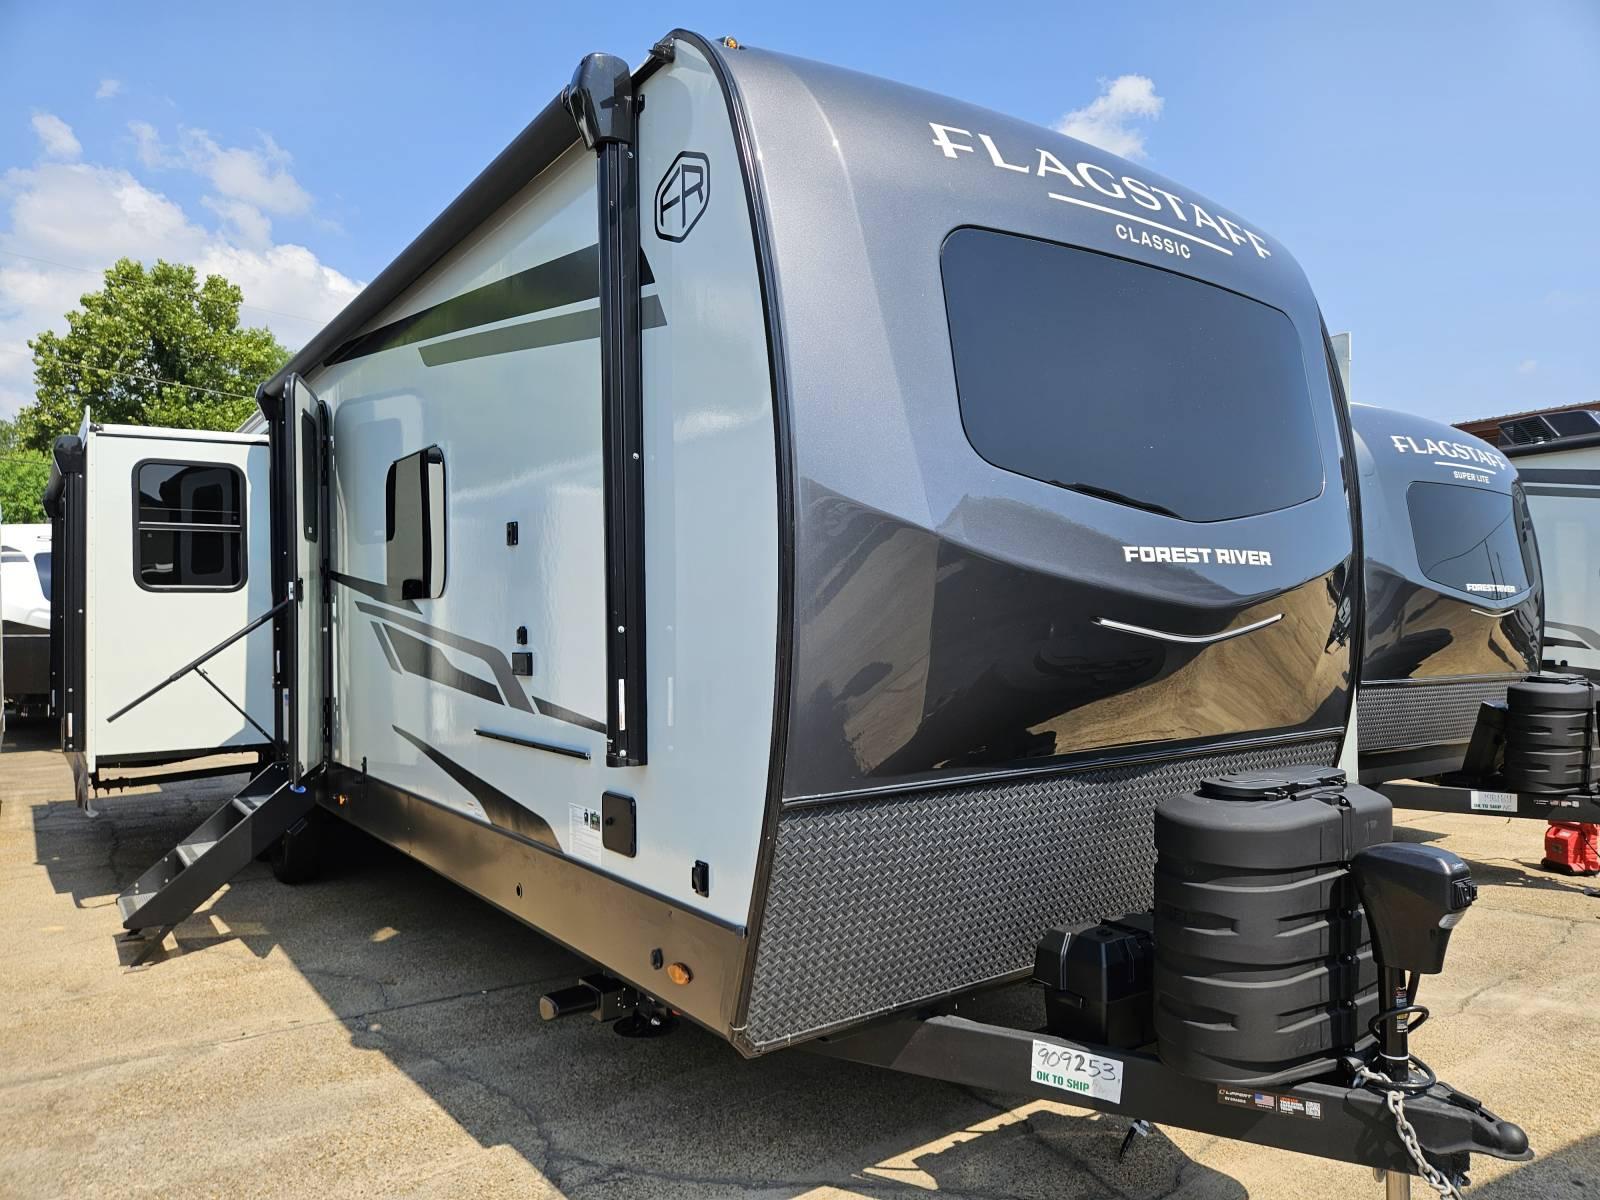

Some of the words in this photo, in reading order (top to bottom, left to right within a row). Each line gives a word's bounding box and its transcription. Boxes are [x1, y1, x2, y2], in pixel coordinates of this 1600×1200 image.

[928, 121, 1272, 259] FLAGSTAFF
[1115, 223, 1192, 260] CLASSIC
[1390, 435, 1506, 470] FLAGSTAFF
[1453, 470, 1476, 481] SUPER
[1476, 474, 1491, 484] LITE
[1122, 546, 1211, 563] FOREST
[1214, 548, 1272, 566] RIVER
[1465, 583, 1496, 592] FOREST
[1496, 584, 1516, 593] RIVER
[1037, 1047, 1116, 1081] 909253
[1036, 1070, 1049, 1082] OK
[1052, 1074, 1064, 1086] TO
[1066, 1078, 1090, 1092] SHIP
